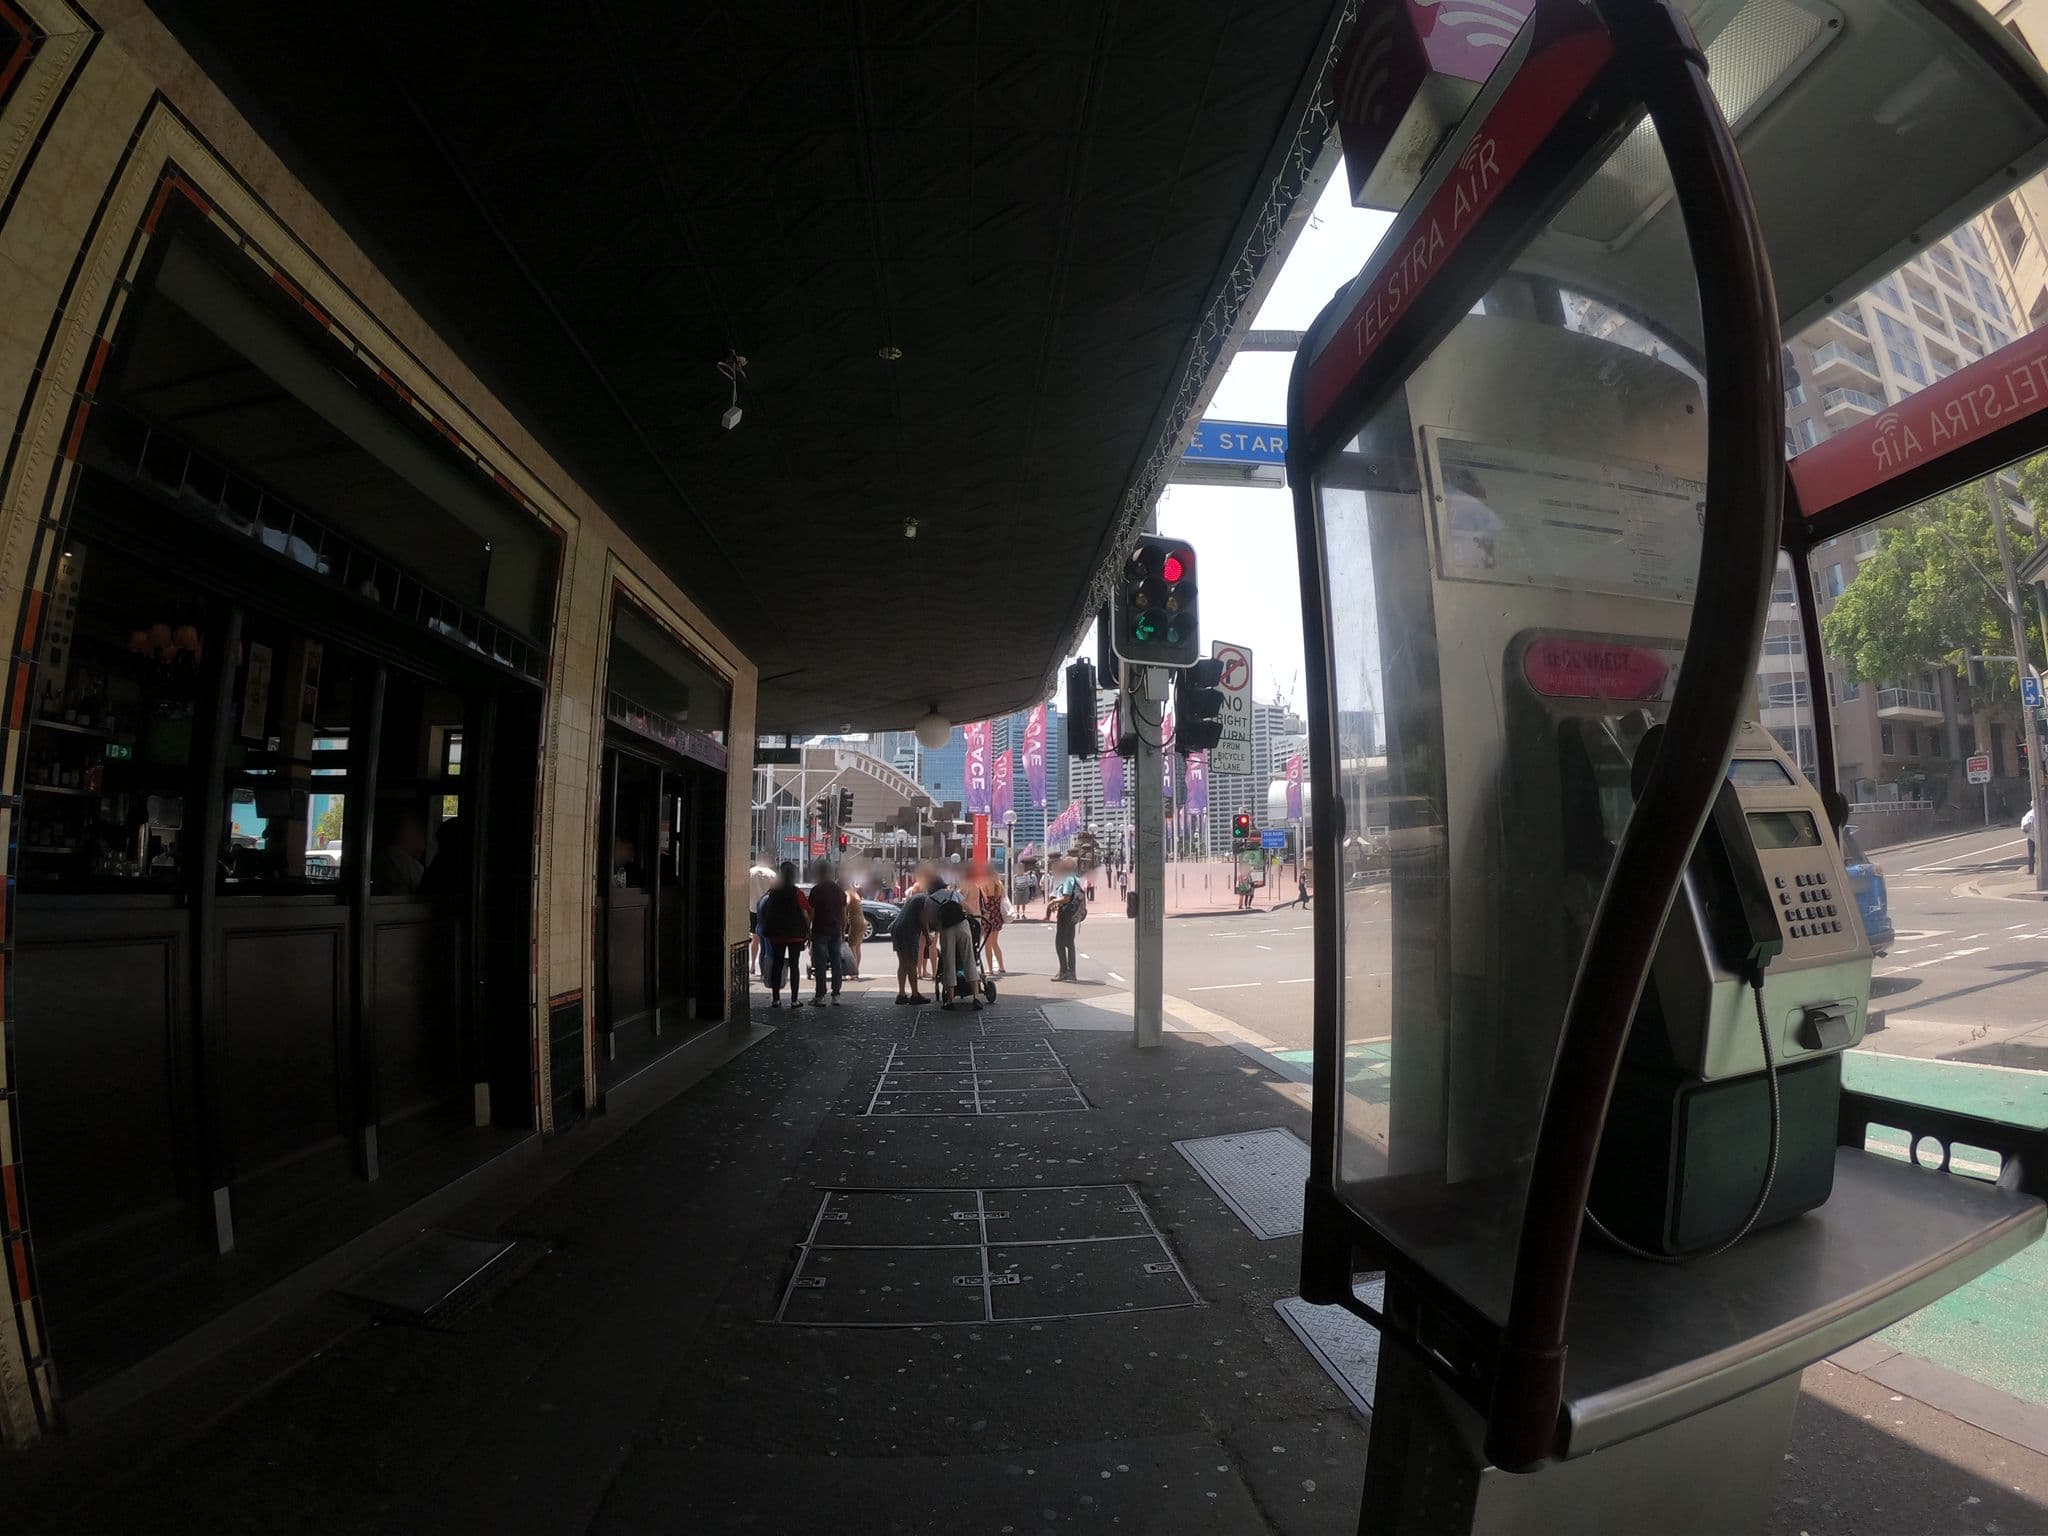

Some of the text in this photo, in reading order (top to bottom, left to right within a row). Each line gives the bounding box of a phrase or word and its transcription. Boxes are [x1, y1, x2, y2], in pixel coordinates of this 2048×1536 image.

[1353, 217, 1444, 357] TELSTRA
[1220, 433, 1285, 453] STAR
[2025, 680, 2034, 692] P
[1221, 695, 1243, 712] NO
[1217, 713, 1248, 729] RIGHT
[1223, 729, 1246, 741] URN
[1222, 741, 1241, 751] FROM
[1217, 751, 1246, 762] BICYCLE
[1222, 763, 1241, 771] LANE
